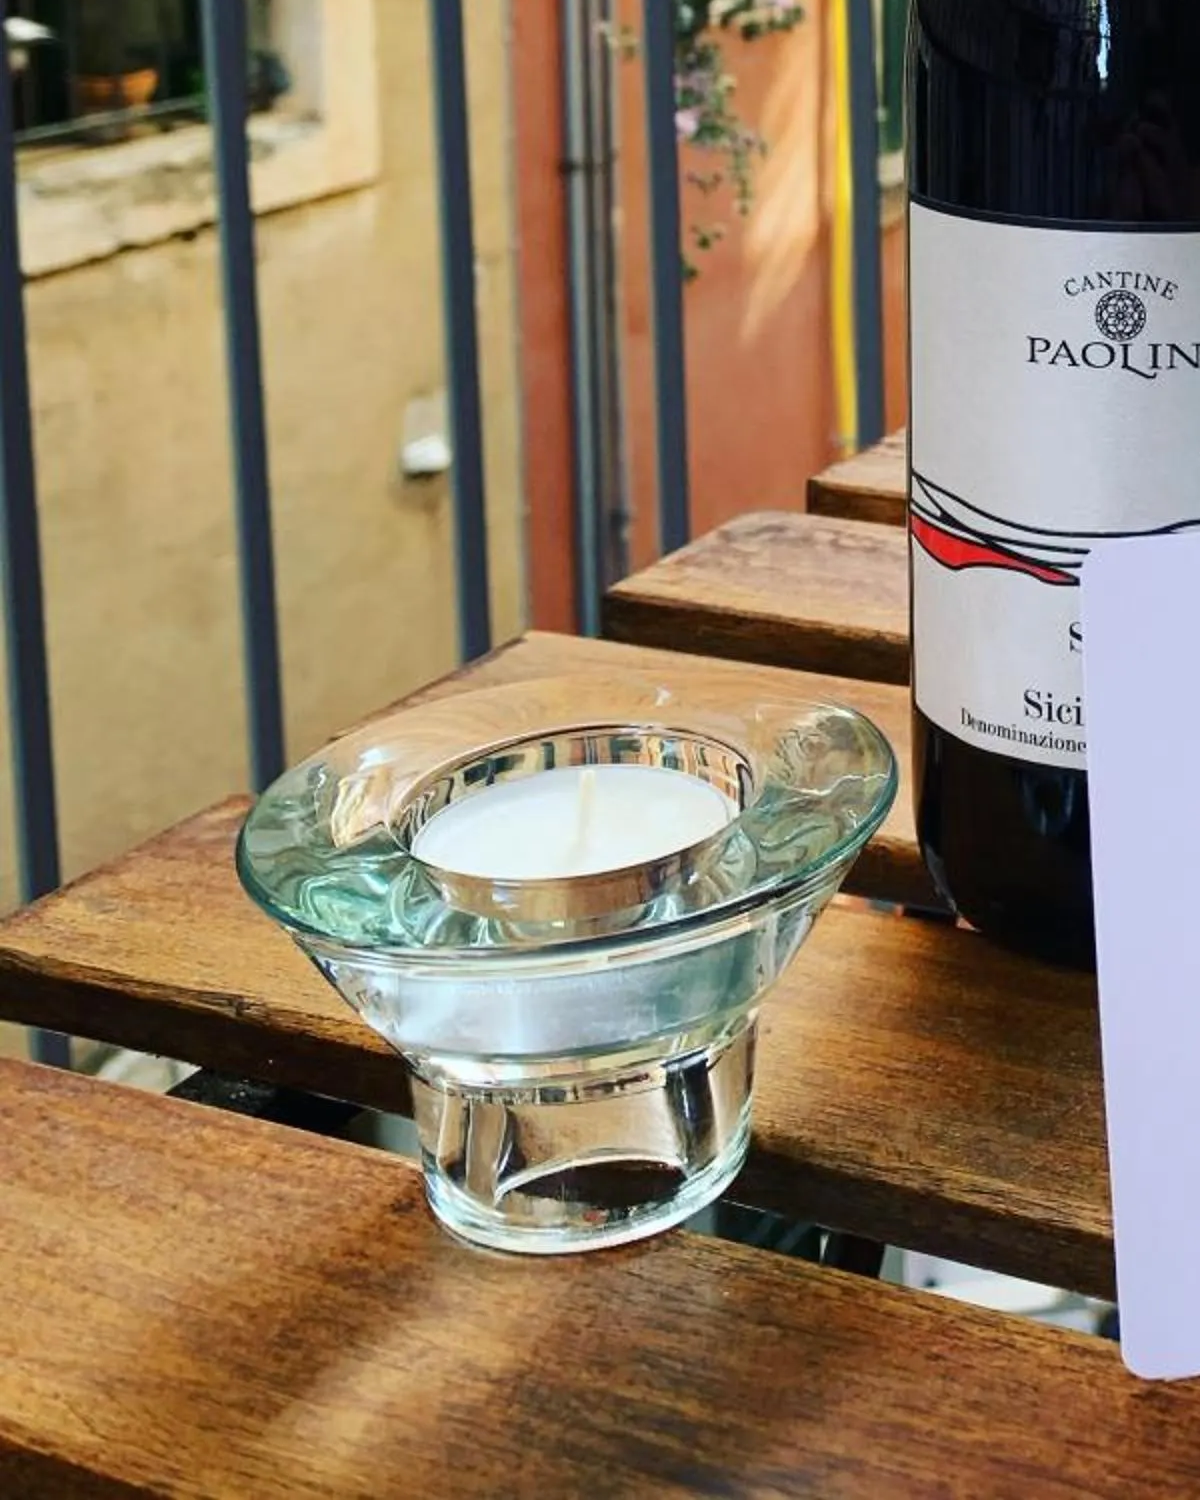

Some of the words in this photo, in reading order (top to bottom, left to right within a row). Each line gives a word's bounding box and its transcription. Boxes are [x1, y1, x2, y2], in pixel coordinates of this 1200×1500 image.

[1063, 271, 1179, 300] CANTINE
[1023, 689, 1085, 727] Sici
[961, 706, 1087, 754] Denominazione
